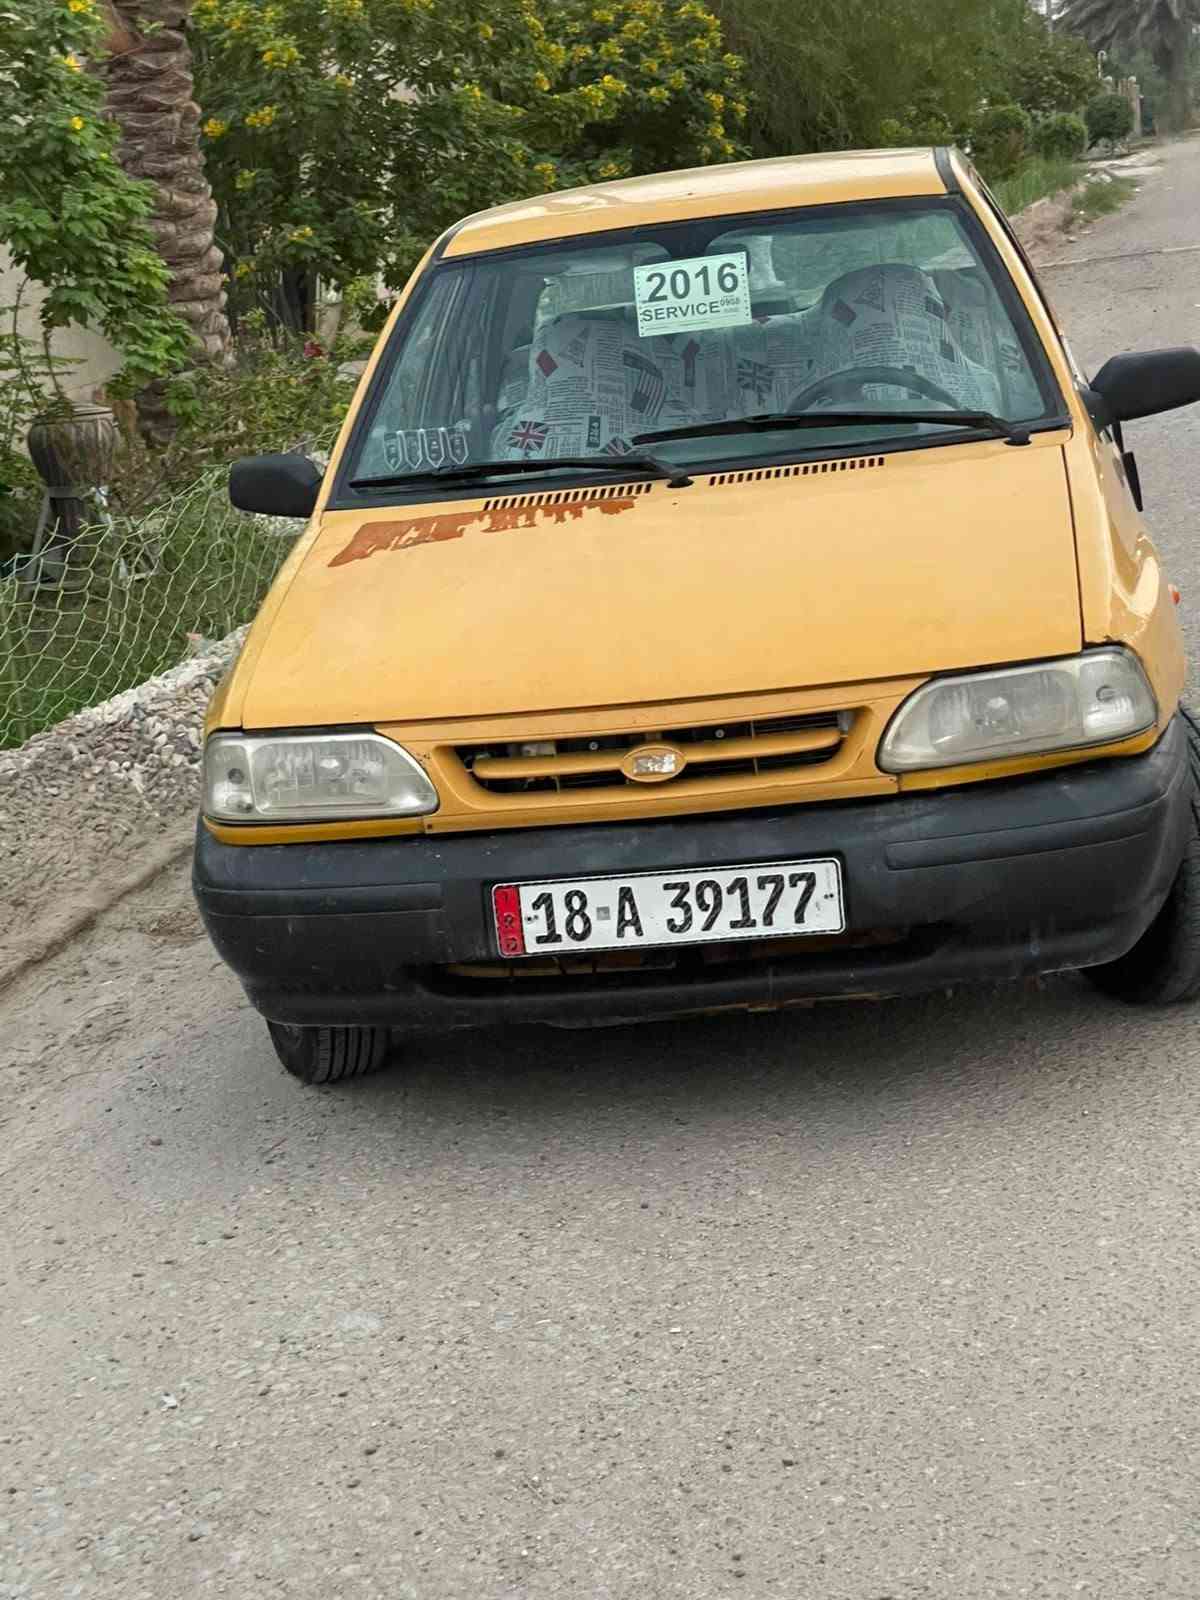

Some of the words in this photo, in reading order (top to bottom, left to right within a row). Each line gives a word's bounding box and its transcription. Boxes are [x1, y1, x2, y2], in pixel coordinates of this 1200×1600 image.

[645, 262, 739, 303] 2016
[641, 300, 721, 322] SERVICE
[531, 889, 593, 945] 18
[616, 886, 645, 939] A
[662, 871, 817, 934] 39177
